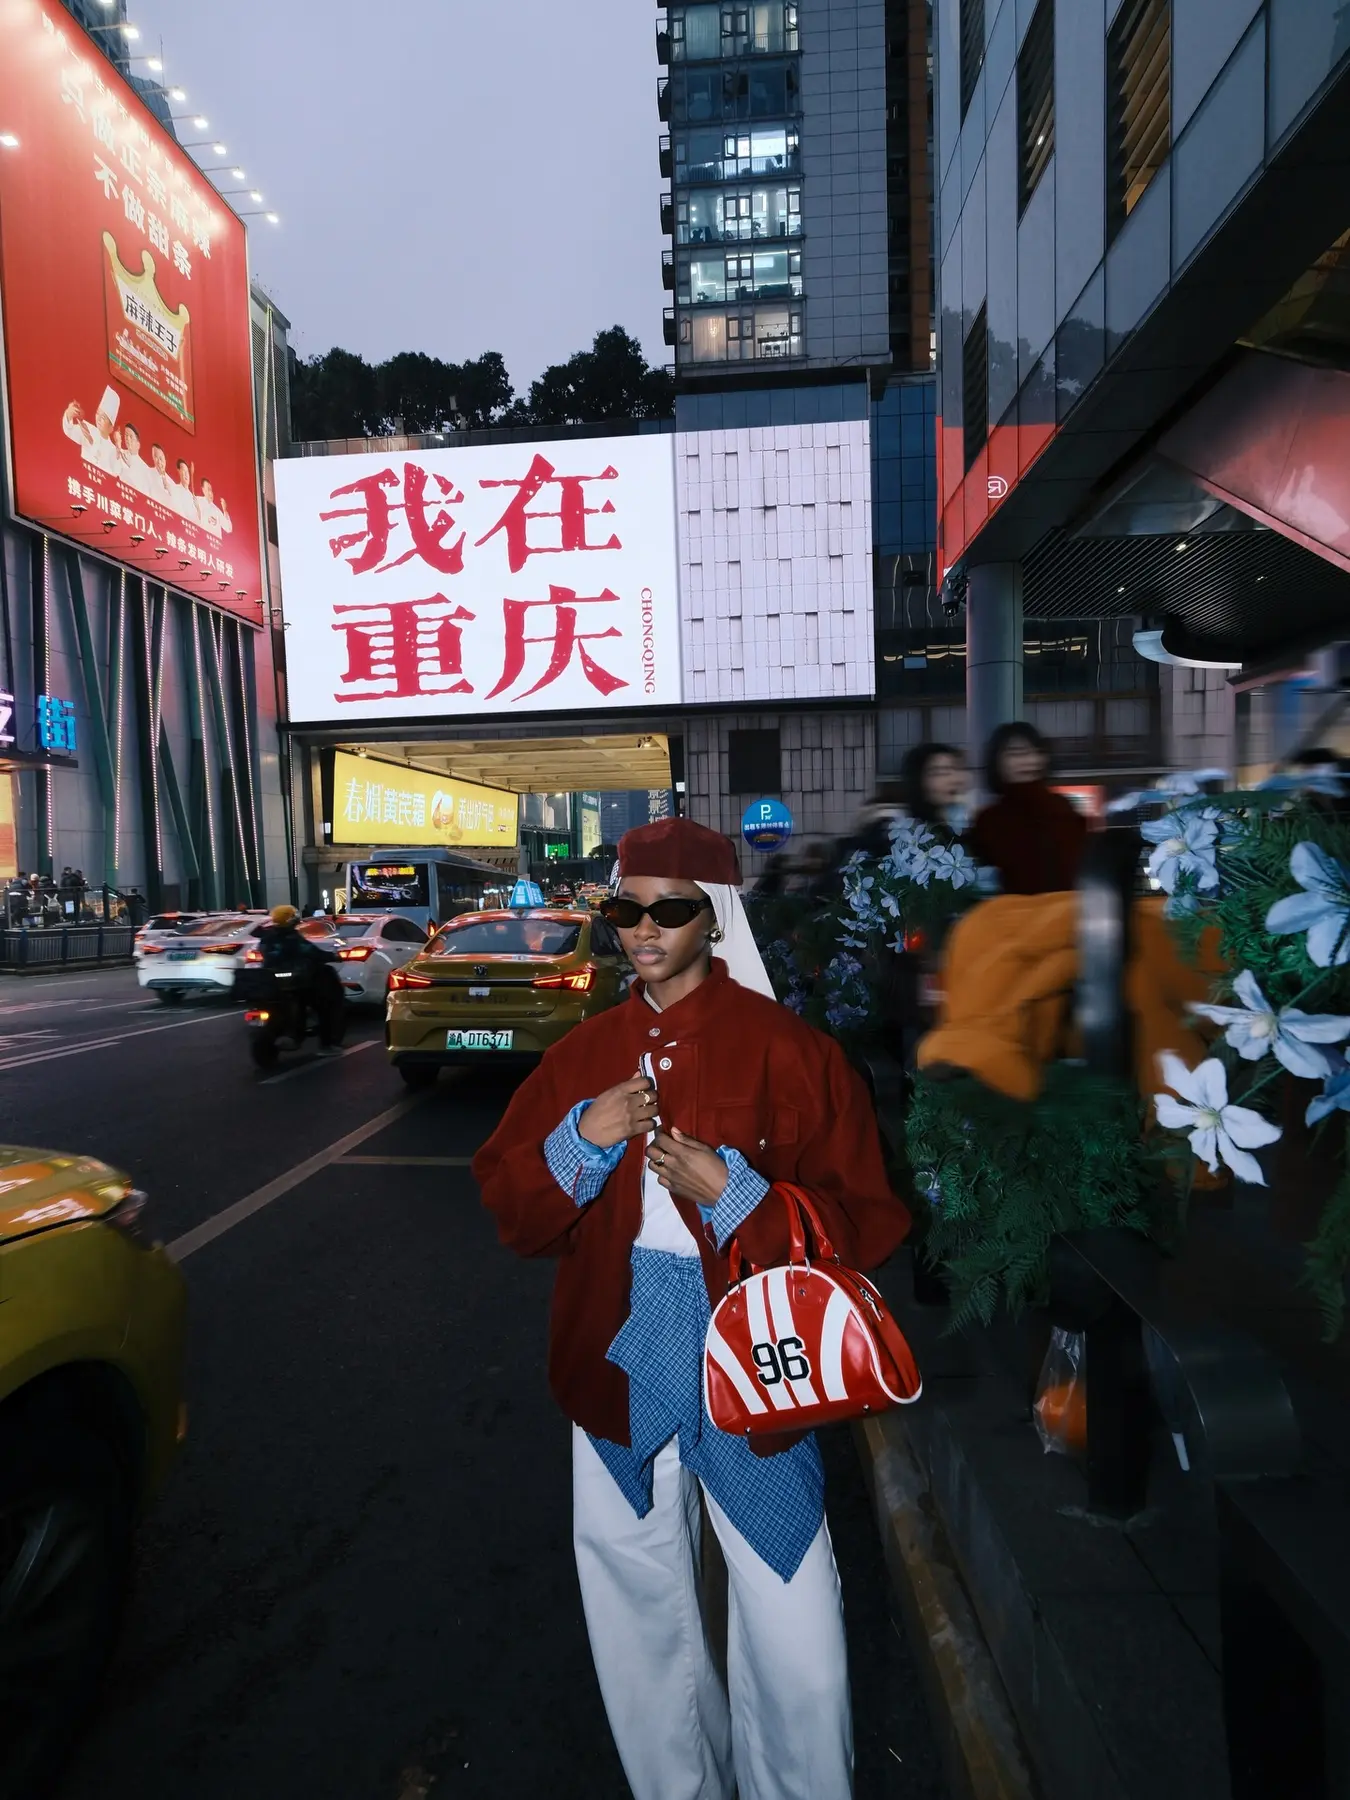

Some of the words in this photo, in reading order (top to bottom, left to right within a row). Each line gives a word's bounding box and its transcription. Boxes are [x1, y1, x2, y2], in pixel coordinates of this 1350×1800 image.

[94, 153, 192, 281] 不做甜条
[125, 293, 178, 354] 麻辣王子
[319, 453, 622, 575] 我在
[331, 584, 630, 703] 重庆
[640, 587, 656, 694] CHONGQING
[751, 1335, 812, 1386] 96
